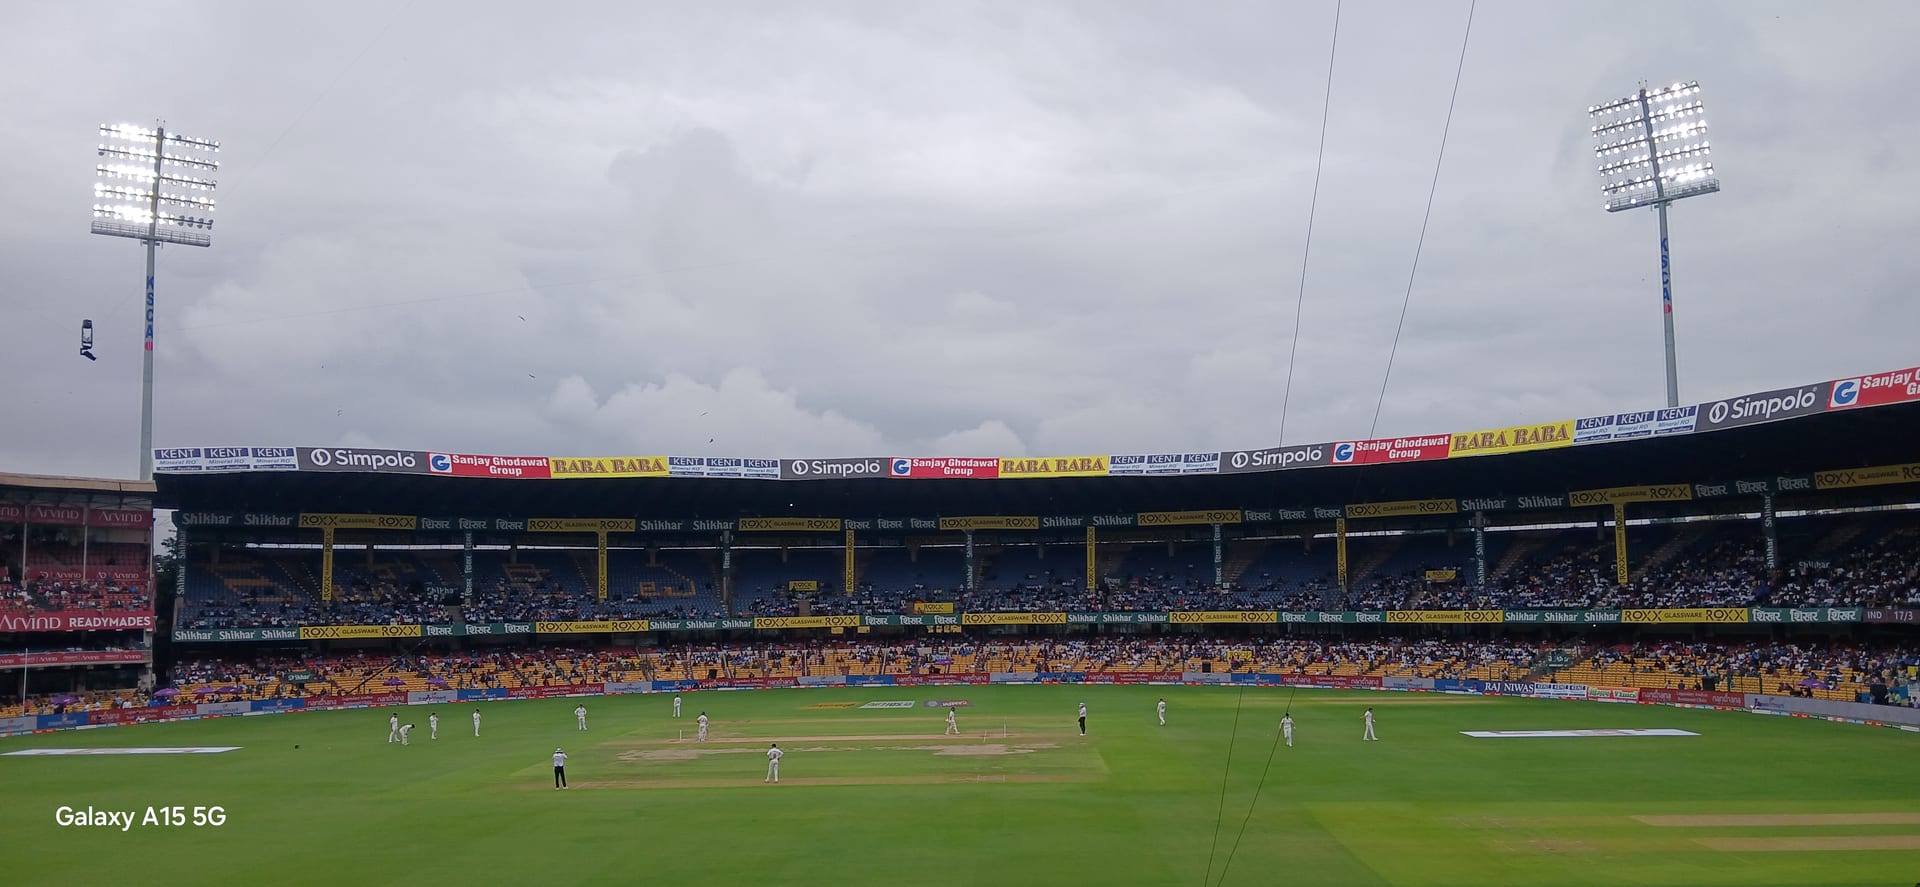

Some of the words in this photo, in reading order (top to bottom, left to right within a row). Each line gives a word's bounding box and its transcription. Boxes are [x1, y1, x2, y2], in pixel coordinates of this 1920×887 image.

[1862, 372, 1912, 388] Sanjay
[1731, 389, 1816, 419] Simpolo
[1622, 412, 1649, 424] KENT
[1662, 408, 1691, 420] KENT
[1581, 416, 1609, 428] KENT
[1452, 432, 1508, 451] BABA
[1513, 423, 1570, 446] BABA
[1356, 440, 1392, 452] Sanjay
[1394, 436, 1448, 449] Ghodawat
[161, 449, 195, 459] KENT
[210, 448, 243, 457] KENT
[257, 448, 288, 457] KENT
[1188, 453, 1214, 462] KENT
[1252, 447, 1322, 466] Simpolo
[1389, 448, 1421, 459] Group
[336, 450, 416, 469] Simpolo
[452, 455, 490, 466] Sanjay
[492, 457, 548, 467] Ghodawat
[674, 457, 699, 465] KENT
[711, 458, 736, 466] KENT
[748, 459, 773, 467] KENT
[913, 459, 945, 468] Sanjay
[948, 459, 997, 467] Ghodawat
[1115, 456, 1140, 464] KENT
[1151, 455, 1177, 463] KENT
[490, 465, 522, 476] Group
[552, 459, 608, 473] BABA
[611, 458, 666, 472] BABA
[812, 460, 880, 477] Simpolo
[1001, 459, 1051, 474] BABA
[1055, 458, 1105, 472] BABA
[944, 467, 973, 476] Group
[1817, 472, 1856, 486] ROXX
[1572, 491, 1608, 504] ROXX
[1650, 486, 1688, 499] ROXX
[1348, 506, 1381, 516] ROXX
[1419, 501, 1454, 511] ROXX
[1462, 500, 1506, 510] Shikhar
[1518, 496, 1564, 508] Shikhar
[182, 512, 232, 525] Shikhar
[244, 514, 293, 526] Shikhar
[302, 515, 338, 526] ROXX
[378, 517, 414, 527] ROXX
[942, 518, 972, 527] ROXX
[1006, 518, 1036, 527] ROXX
[1042, 516, 1083, 527] Shikhar
[1092, 515, 1134, 525] Shikhar
[1140, 514, 1171, 523] ROXX
[1207, 512, 1238, 521] ROXX
[530, 520, 562, 530] ROXX
[600, 520, 632, 529] ROXX
[640, 520, 682, 530] Shikhar
[693, 520, 734, 530] Shikhar
[741, 520, 772, 528] ROXX
[807, 520, 838, 529] ROXX
[865, 615, 889, 625] शिखर
[900, 615, 923, 624] शिखर
[934, 615, 958, 624] शिखर
[964, 615, 995, 624] ROXX
[1032, 614, 1063, 623] ROXX
[1068, 613, 1098, 622] Shikhar
[1102, 613, 1132, 622] Shikhar
[1137, 613, 1168, 622] Shikhar
[1172, 613, 1203, 622] ROXX
[1241, 612, 1274, 622] ROXX
[1282, 612, 1307, 622] शिखर
[1319, 612, 1343, 622] शिखर
[1356, 612, 1381, 622] शिखर
[1389, 612, 1424, 622] ROXX
[1464, 611, 1499, 621] ROXX
[1505, 612, 1538, 622] Shikhar
[1544, 612, 1578, 622] Shikhar
[1584, 612, 1620, 622] Shikhar
[1625, 610, 1662, 622] ROXX
[1705, 610, 1744, 622] ROXX
[1752, 609, 1782, 621] शिखर
[1790, 609, 1819, 621] शिखर
[1828, 608, 1857, 621] शिखर
[1868, 611, 1882, 619] IND
[1894, 611, 1913, 621] 17/3
[69, 617, 151, 627] READYMADES
[539, 622, 572, 632] ROXX
[612, 621, 645, 631] ROXX
[650, 619, 680, 629] Shikhar
[686, 619, 716, 629] Shikhar
[722, 619, 752, 628] Shikhar
[757, 618, 788, 627] ROXX
[825, 617, 856, 626] ROXX
[175, 630, 212, 641] Shikhar
[219, 629, 255, 639] Shikhar
[262, 629, 297, 639] Shikhar
[303, 627, 340, 637] ROXX
[382, 626, 417, 636] ROXX
[427, 625, 452, 636] शिखर
[466, 624, 492, 635] शिखर
[504, 624, 530, 633] शिखर
[1485, 682, 1501, 692] RAJ
[1504, 683, 1534, 692] NIWAS
